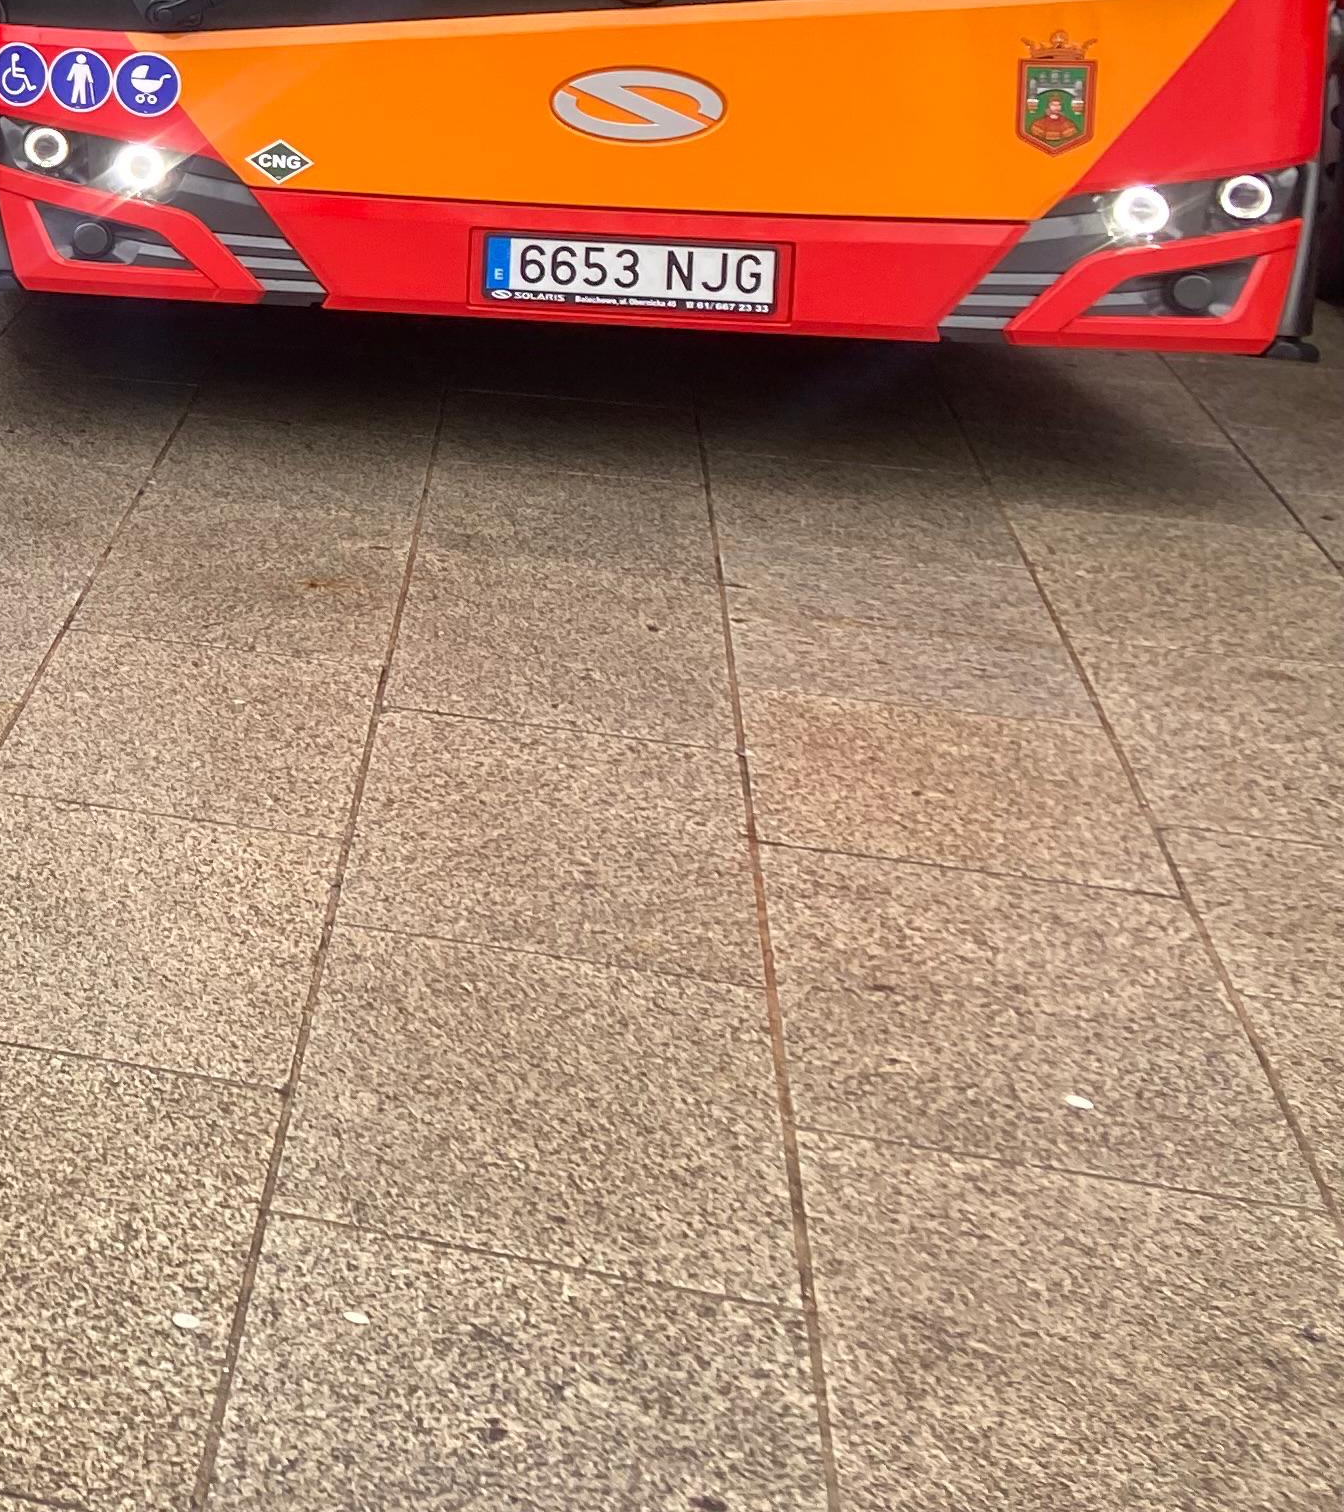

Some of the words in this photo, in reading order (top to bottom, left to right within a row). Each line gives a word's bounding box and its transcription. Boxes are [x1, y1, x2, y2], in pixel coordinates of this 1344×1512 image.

[258, 153, 302, 170] CNG
[494, 268, 504, 280] E
[520, 244, 640, 289] 6653
[666, 249, 762, 294] NJG
[513, 292, 566, 303] SOLARIS
